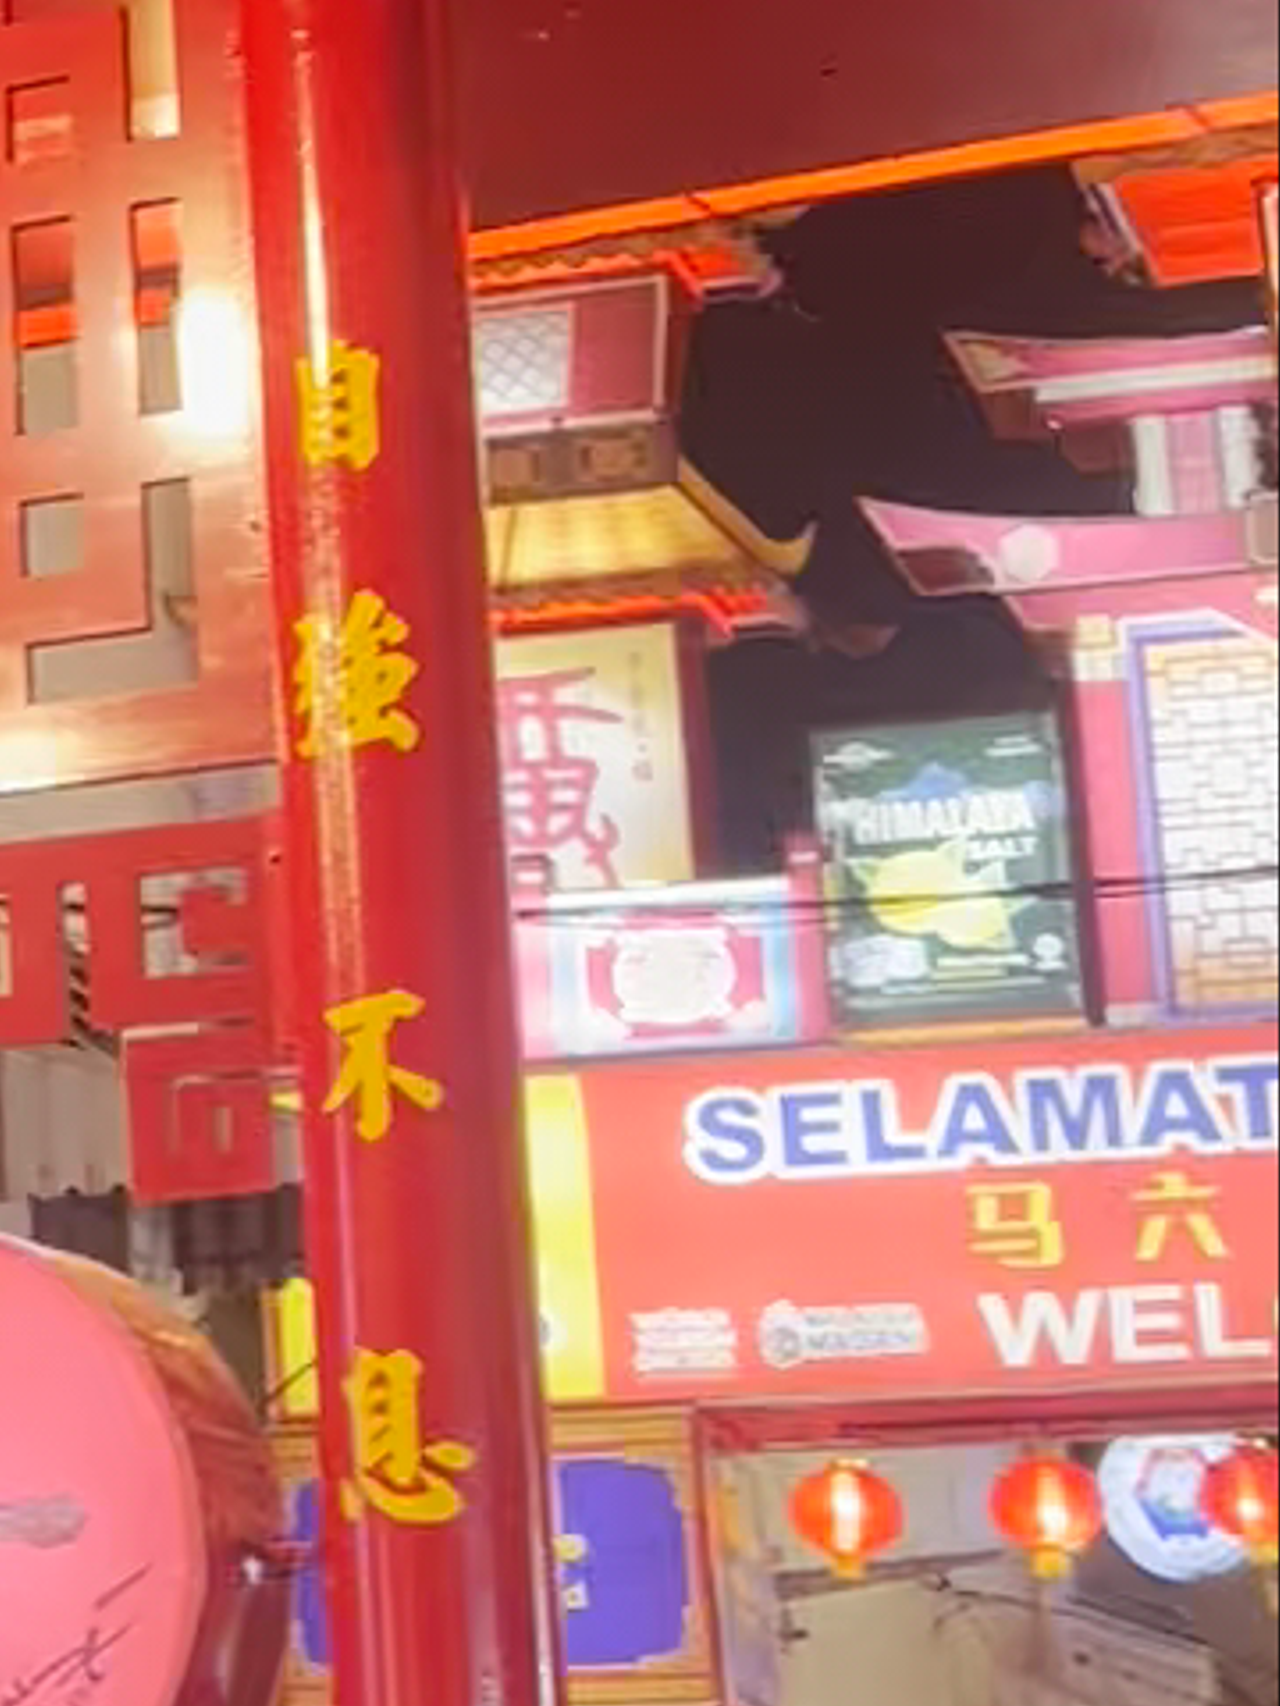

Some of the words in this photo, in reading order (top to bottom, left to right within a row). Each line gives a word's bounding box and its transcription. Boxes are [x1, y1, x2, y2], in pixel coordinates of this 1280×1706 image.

[681, 1052, 1280, 1186] SELAMAT
[965, 1171, 1229, 1269] 马六
[976, 1282, 1280, 1368] WEL
